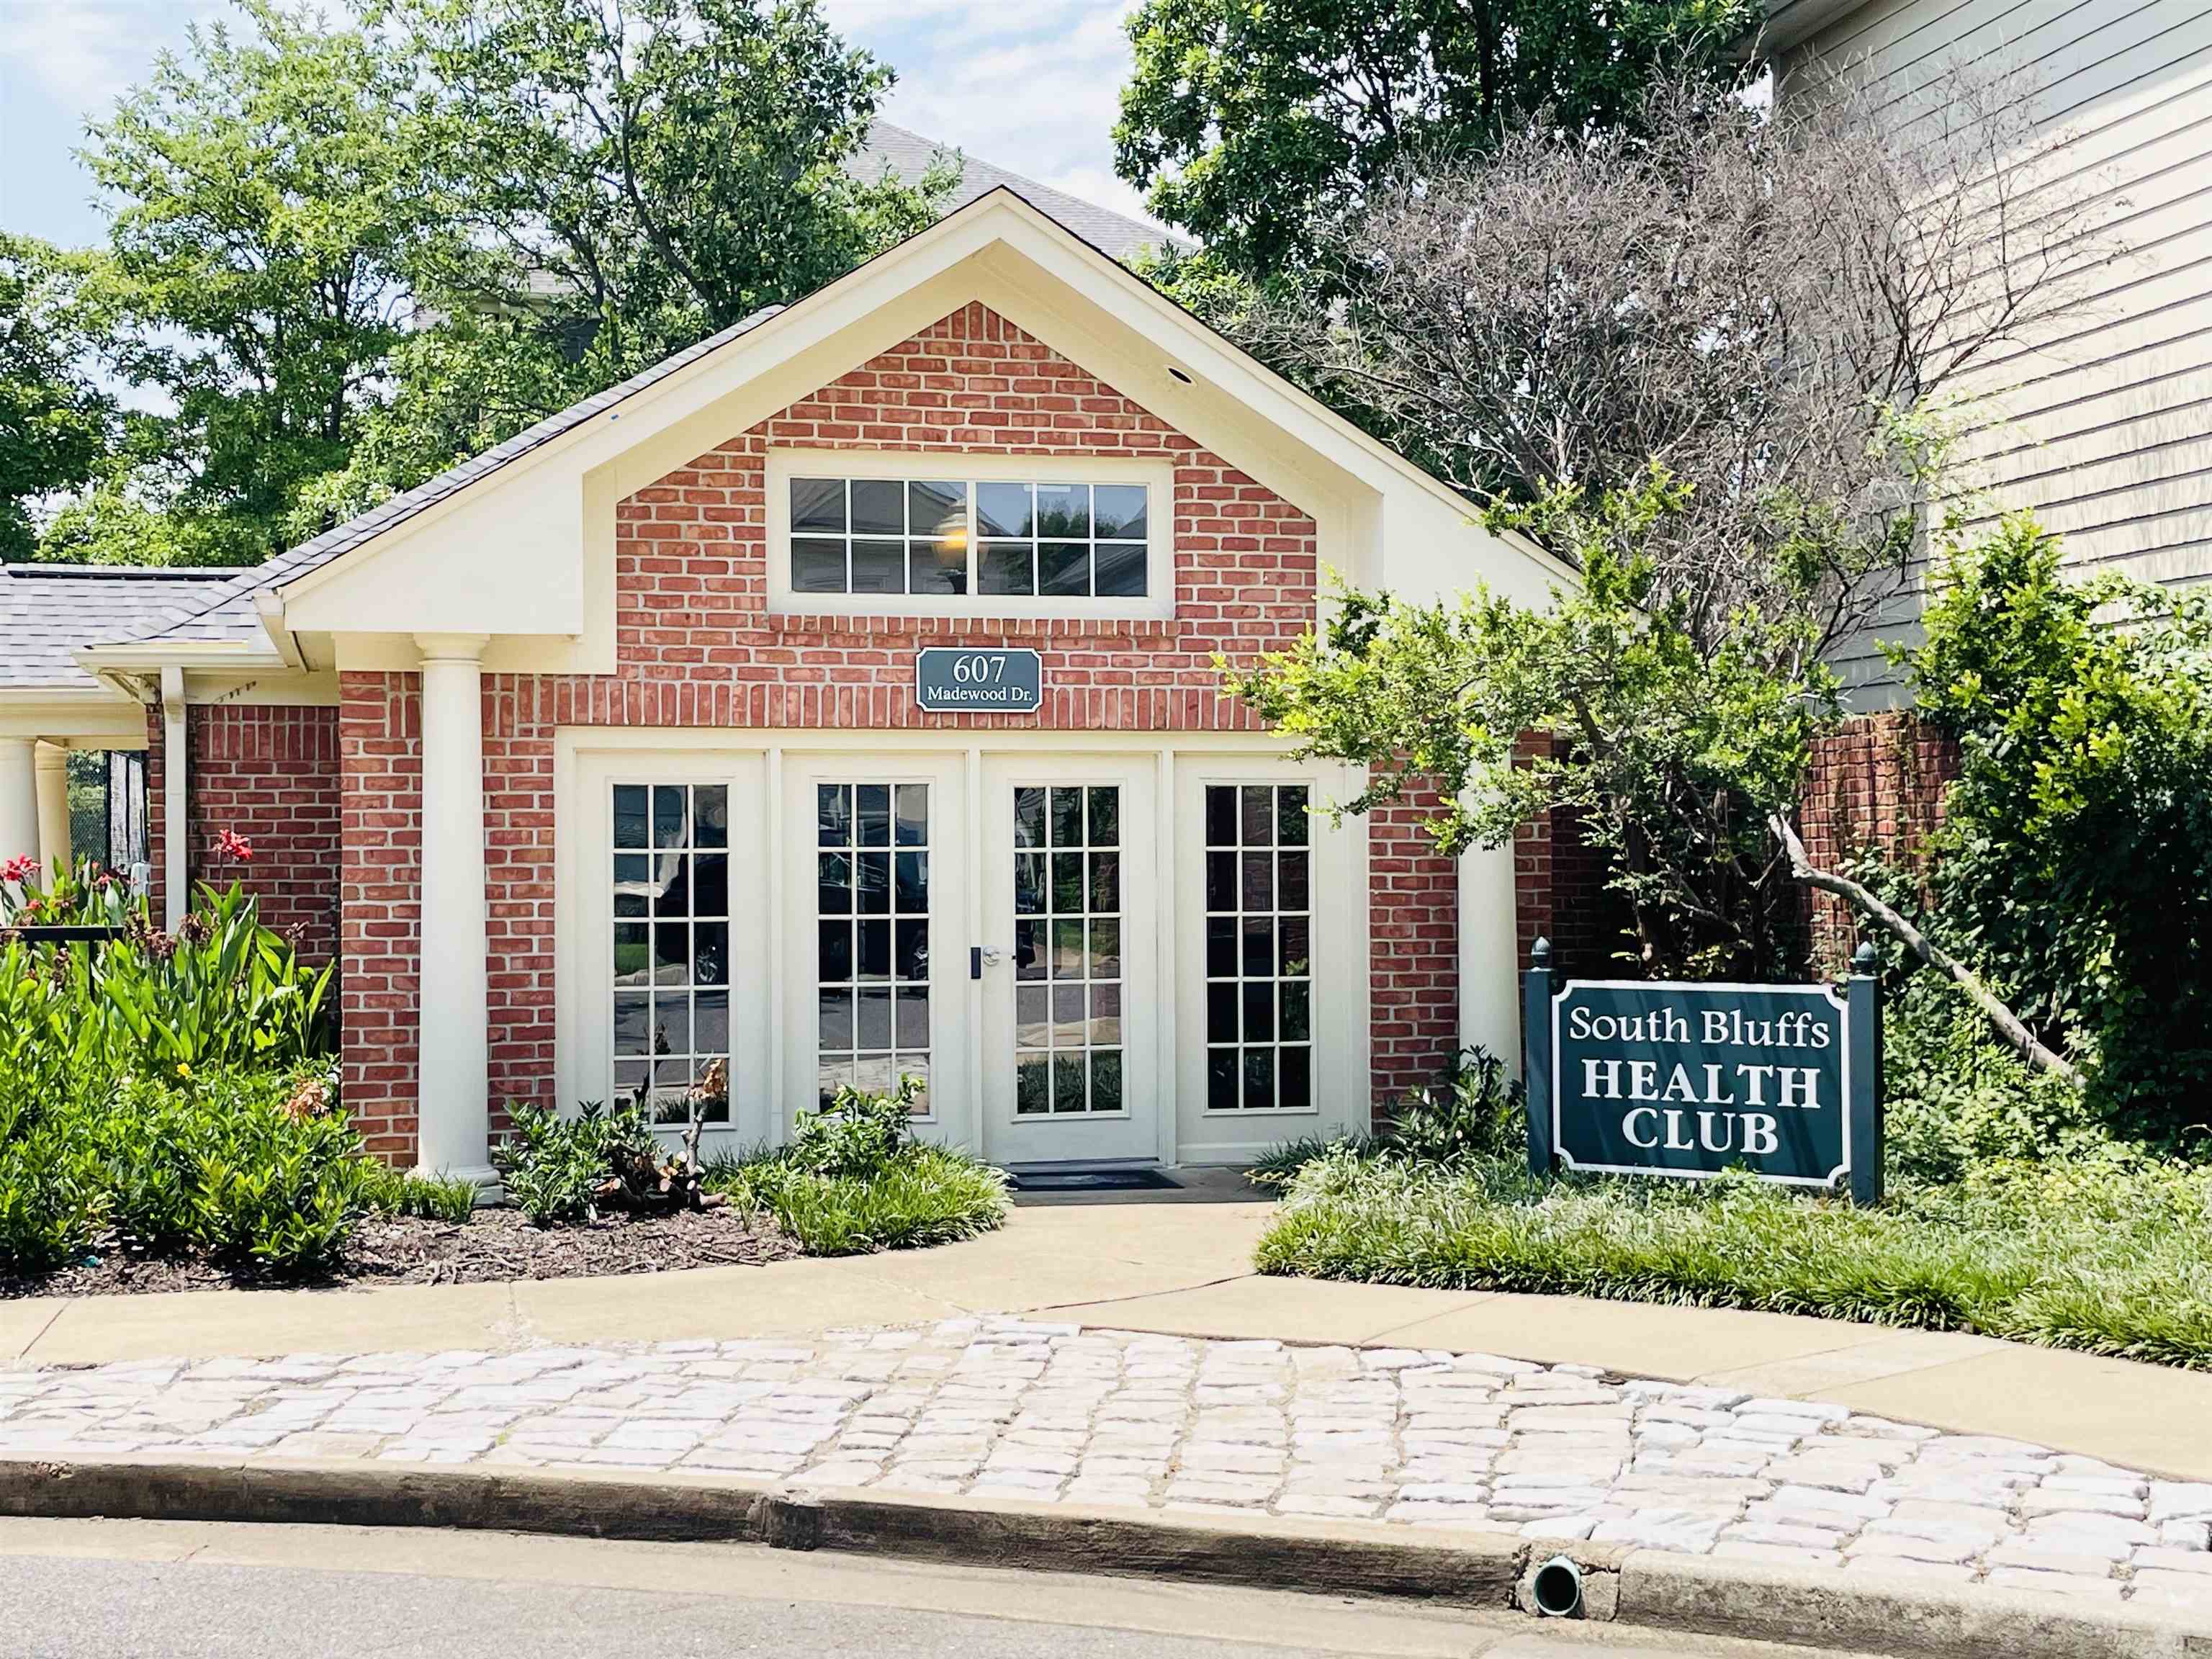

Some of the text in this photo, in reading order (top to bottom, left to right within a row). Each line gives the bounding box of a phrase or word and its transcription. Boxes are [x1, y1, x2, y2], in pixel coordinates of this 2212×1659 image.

[953, 655, 1006, 683] 607
[927, 686, 1033, 701] Madewood Dr.
[1569, 1007, 1830, 1049] South Bluffs
[1581, 1058, 1821, 1109] HEALTH
[1622, 1107, 1779, 1154] CLUB
